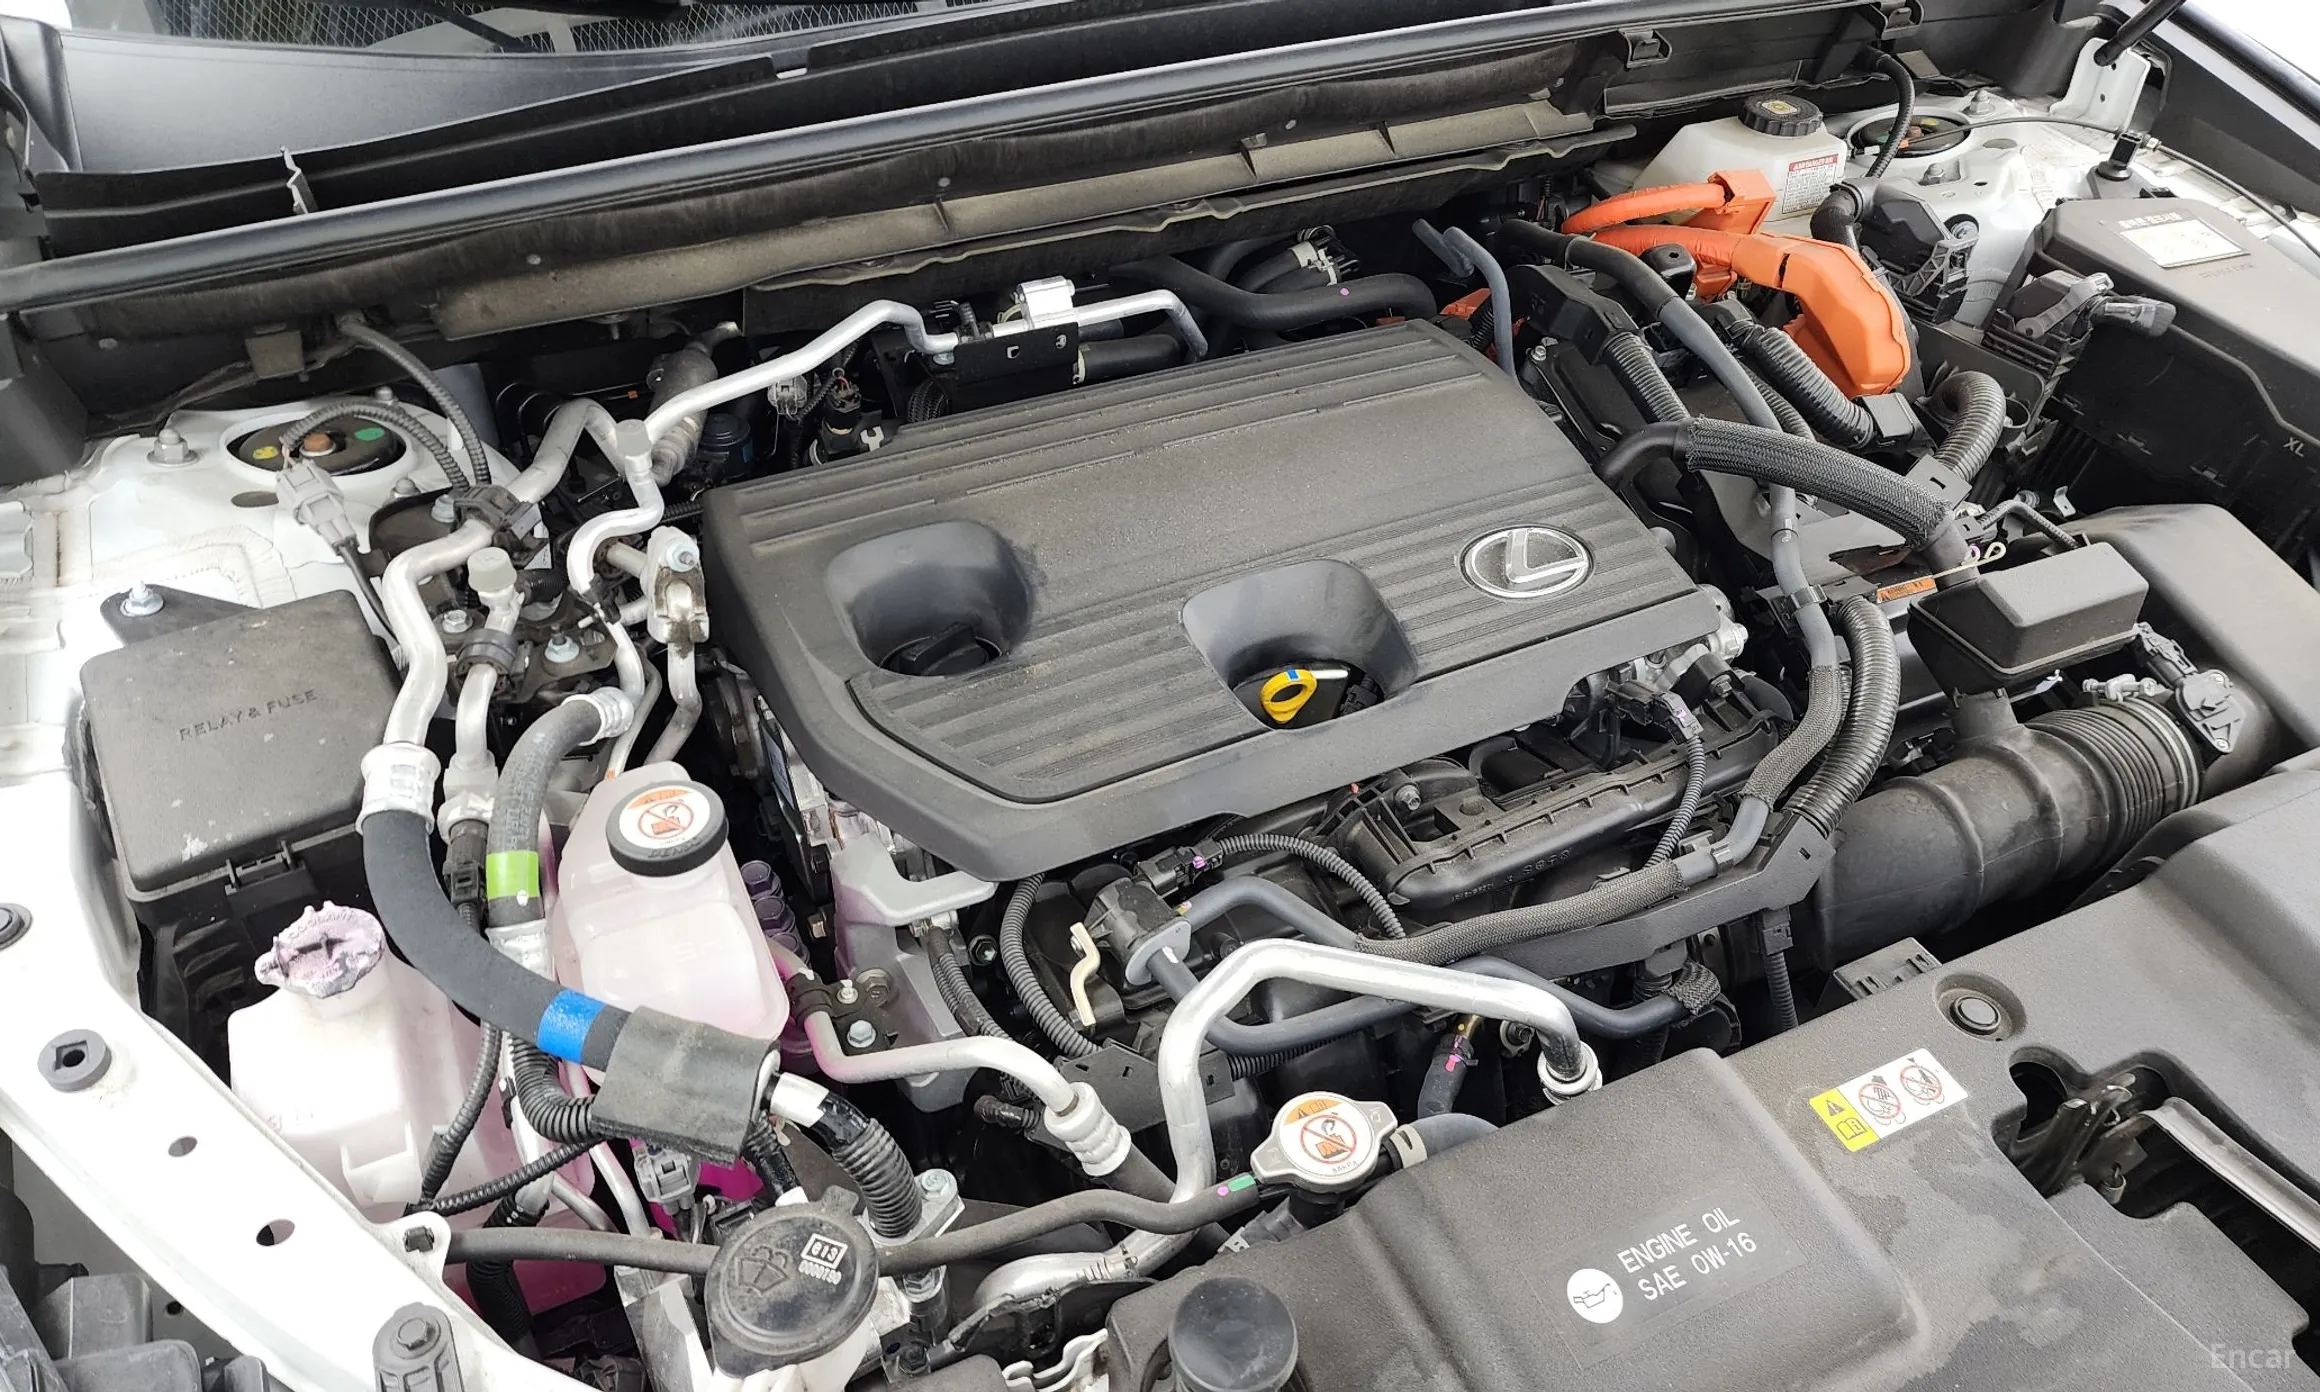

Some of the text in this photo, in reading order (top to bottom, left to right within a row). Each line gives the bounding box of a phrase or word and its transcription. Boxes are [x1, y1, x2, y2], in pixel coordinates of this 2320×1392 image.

[179, 689, 317, 740] RELAY & FUSE
[1616, 1207, 1741, 1273] ENGINE OIL
[1637, 1232, 1757, 1301] SAE 0W-16
